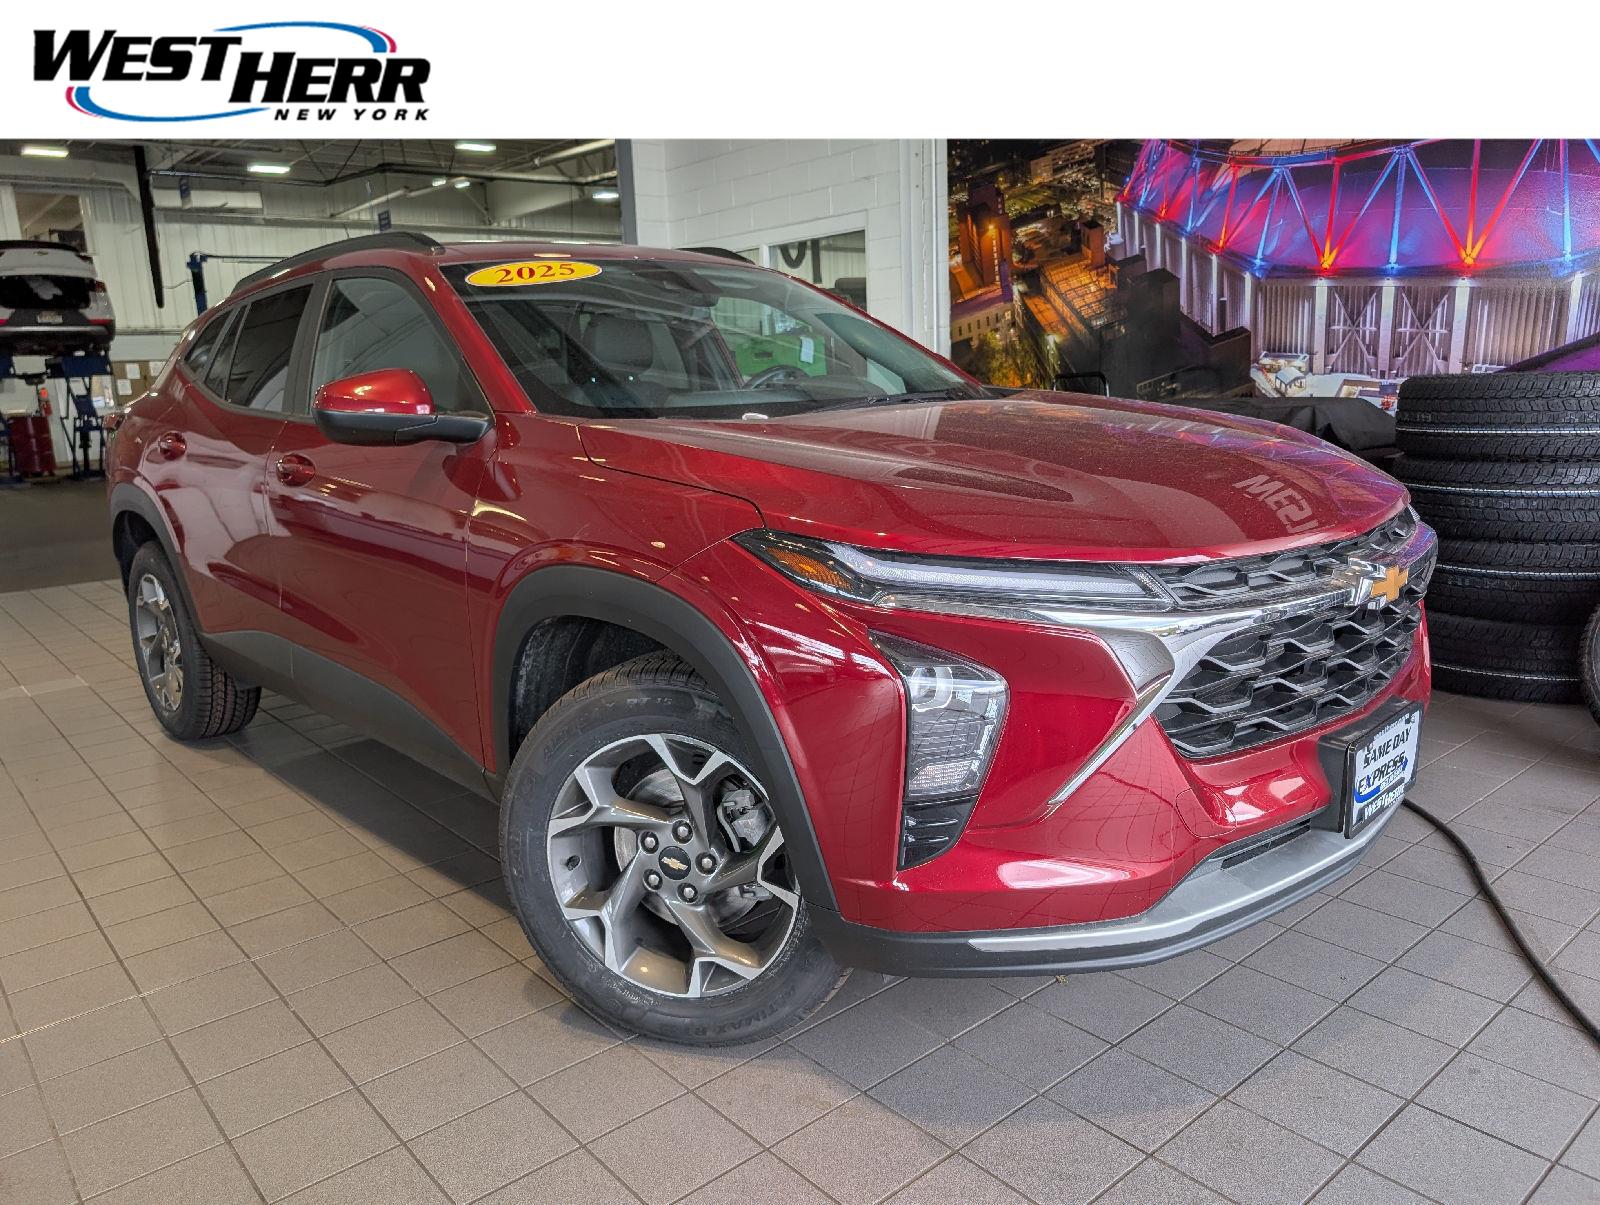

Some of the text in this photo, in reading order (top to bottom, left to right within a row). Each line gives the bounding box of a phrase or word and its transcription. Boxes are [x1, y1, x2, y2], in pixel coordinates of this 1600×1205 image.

[494, 263, 576, 284] 2025
[1363, 739, 1392, 770] SAME
[1393, 725, 1412, 751] DAY
[1357, 750, 1406, 795] EXPRESS
